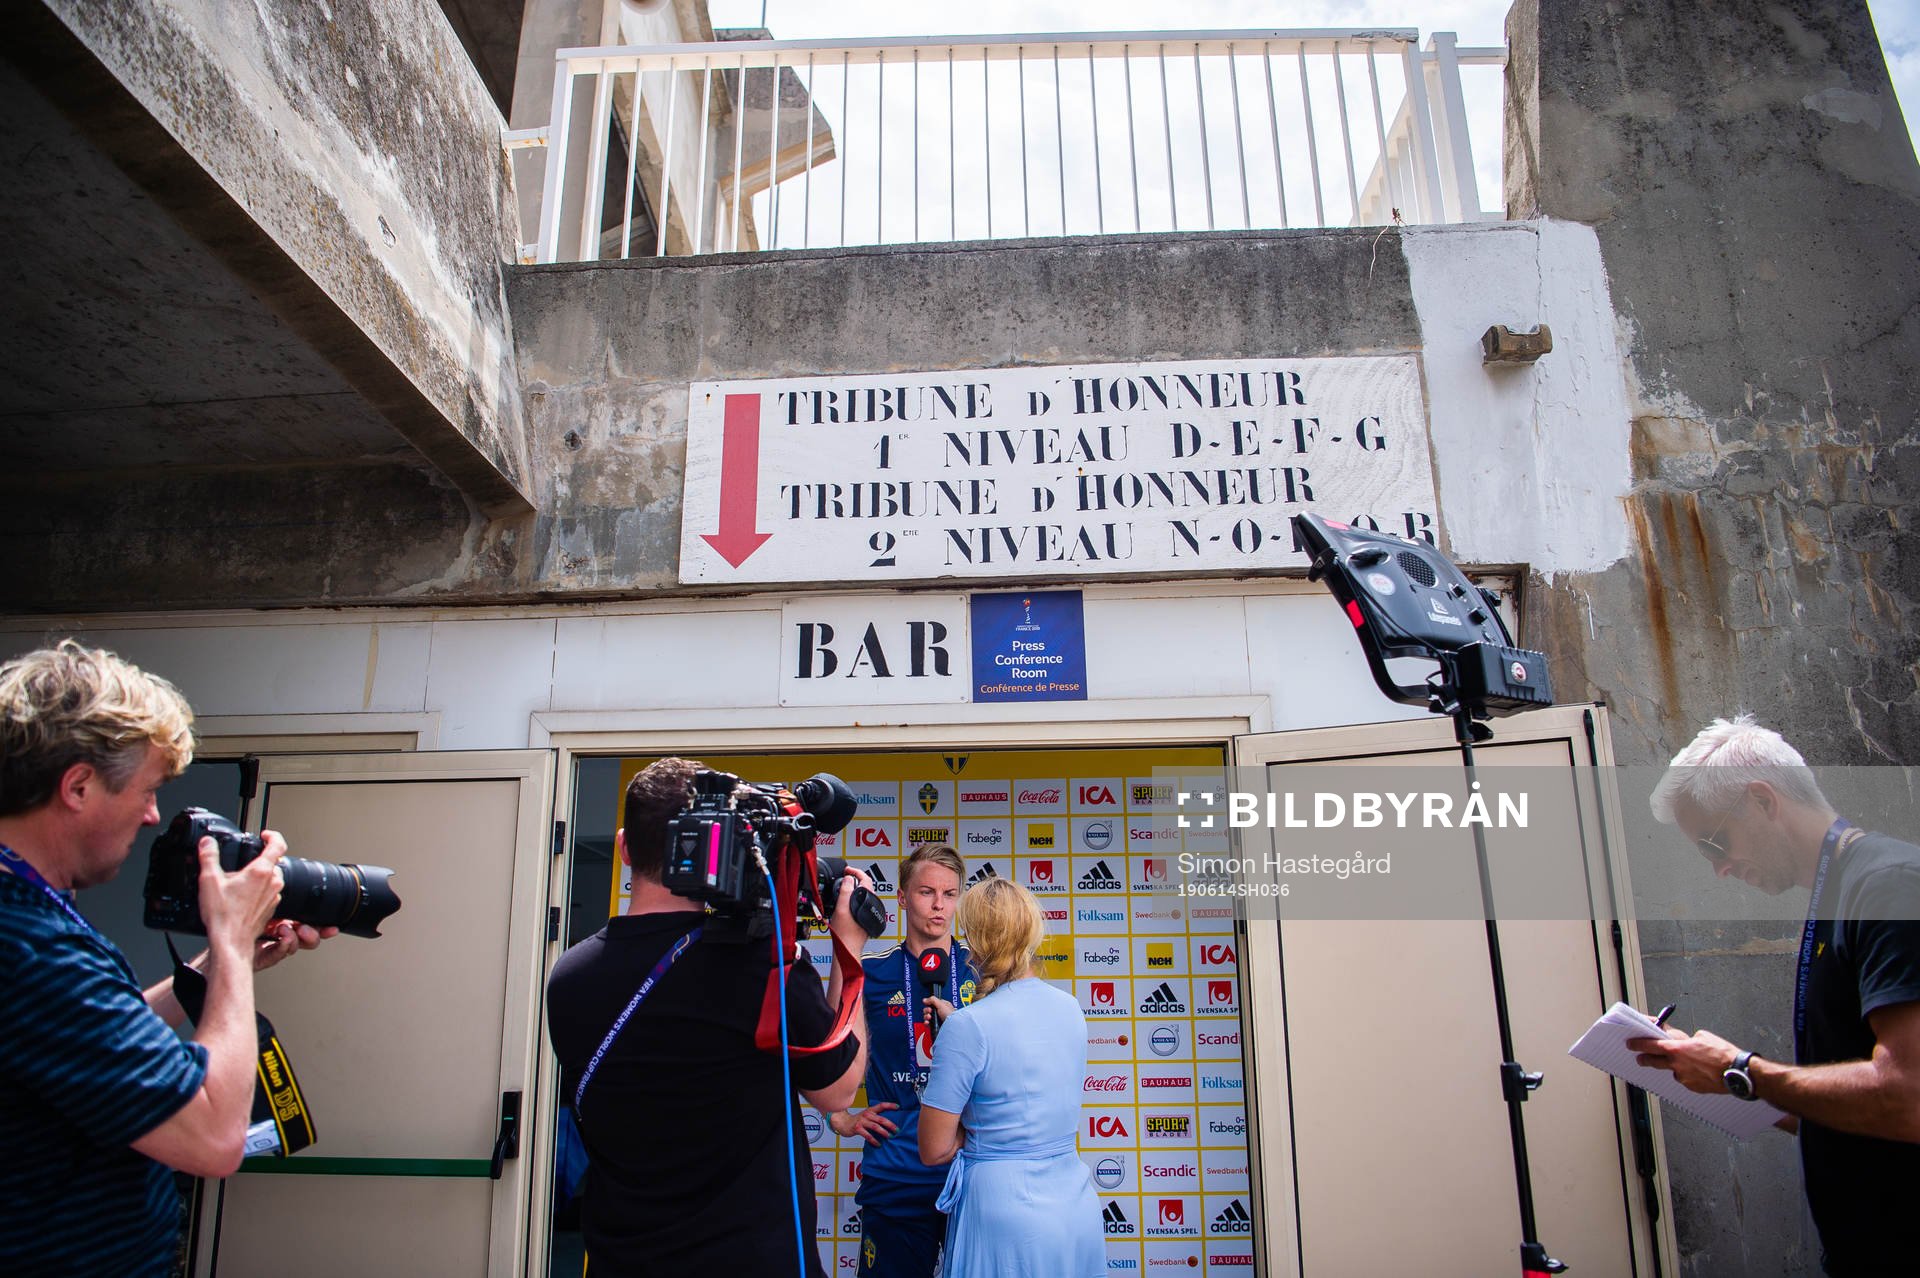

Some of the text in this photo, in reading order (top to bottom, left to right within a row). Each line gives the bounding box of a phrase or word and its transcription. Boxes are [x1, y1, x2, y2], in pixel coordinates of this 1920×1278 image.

[778, 383, 993, 425] TRIBUNE
[943, 425, 1129, 468] NIVEAU
[780, 479, 998, 520] TRIBUNE
[944, 523, 1133, 565] NIVEAU
[794, 621, 952, 679] BAR
[1012, 641, 1045, 651] Press
[995, 654, 1063, 666] Conference
[1012, 668, 1047, 679] Room
[980, 682, 1080, 694] Conférence de Presse
[855, 793, 895, 805] olksam
[961, 793, 1008, 802] BAUHAUS
[1079, 786, 1116, 804] ICA
[1133, 786, 1173, 800] SPORT
[855, 828, 892, 847] ICA
[908, 828, 949, 843] SPORT
[967, 832, 1002, 845] Fabege
[1130, 829, 1179, 840] Scandic
[1077, 878, 1122, 890] adidas
[1077, 909, 1124, 921] Folksam
[1135, 911, 1171, 919] Swedbank
[1802, 930, 1814, 965] WORLD
[1820, 855, 1830, 874] 2019
[1084, 951, 1120, 965] Fabege
[1201, 944, 1236, 965] ICA
[925, 954, 936, 969] 4
[888, 1006, 906, 1017] ICA
[1140, 1001, 1186, 1013] adidas
[262, 1050, 300, 1122] Nikon D5
[1142, 1078, 1191, 1087] BAUHAUS
[1089, 1116, 1128, 1137] ICA
[1146, 1117, 1189, 1132] SPORT
[1144, 1164, 1196, 1177] Scandic
[1206, 1167, 1244, 1175] Swedbank
[1149, 1258, 1187, 1266] Swedbank
